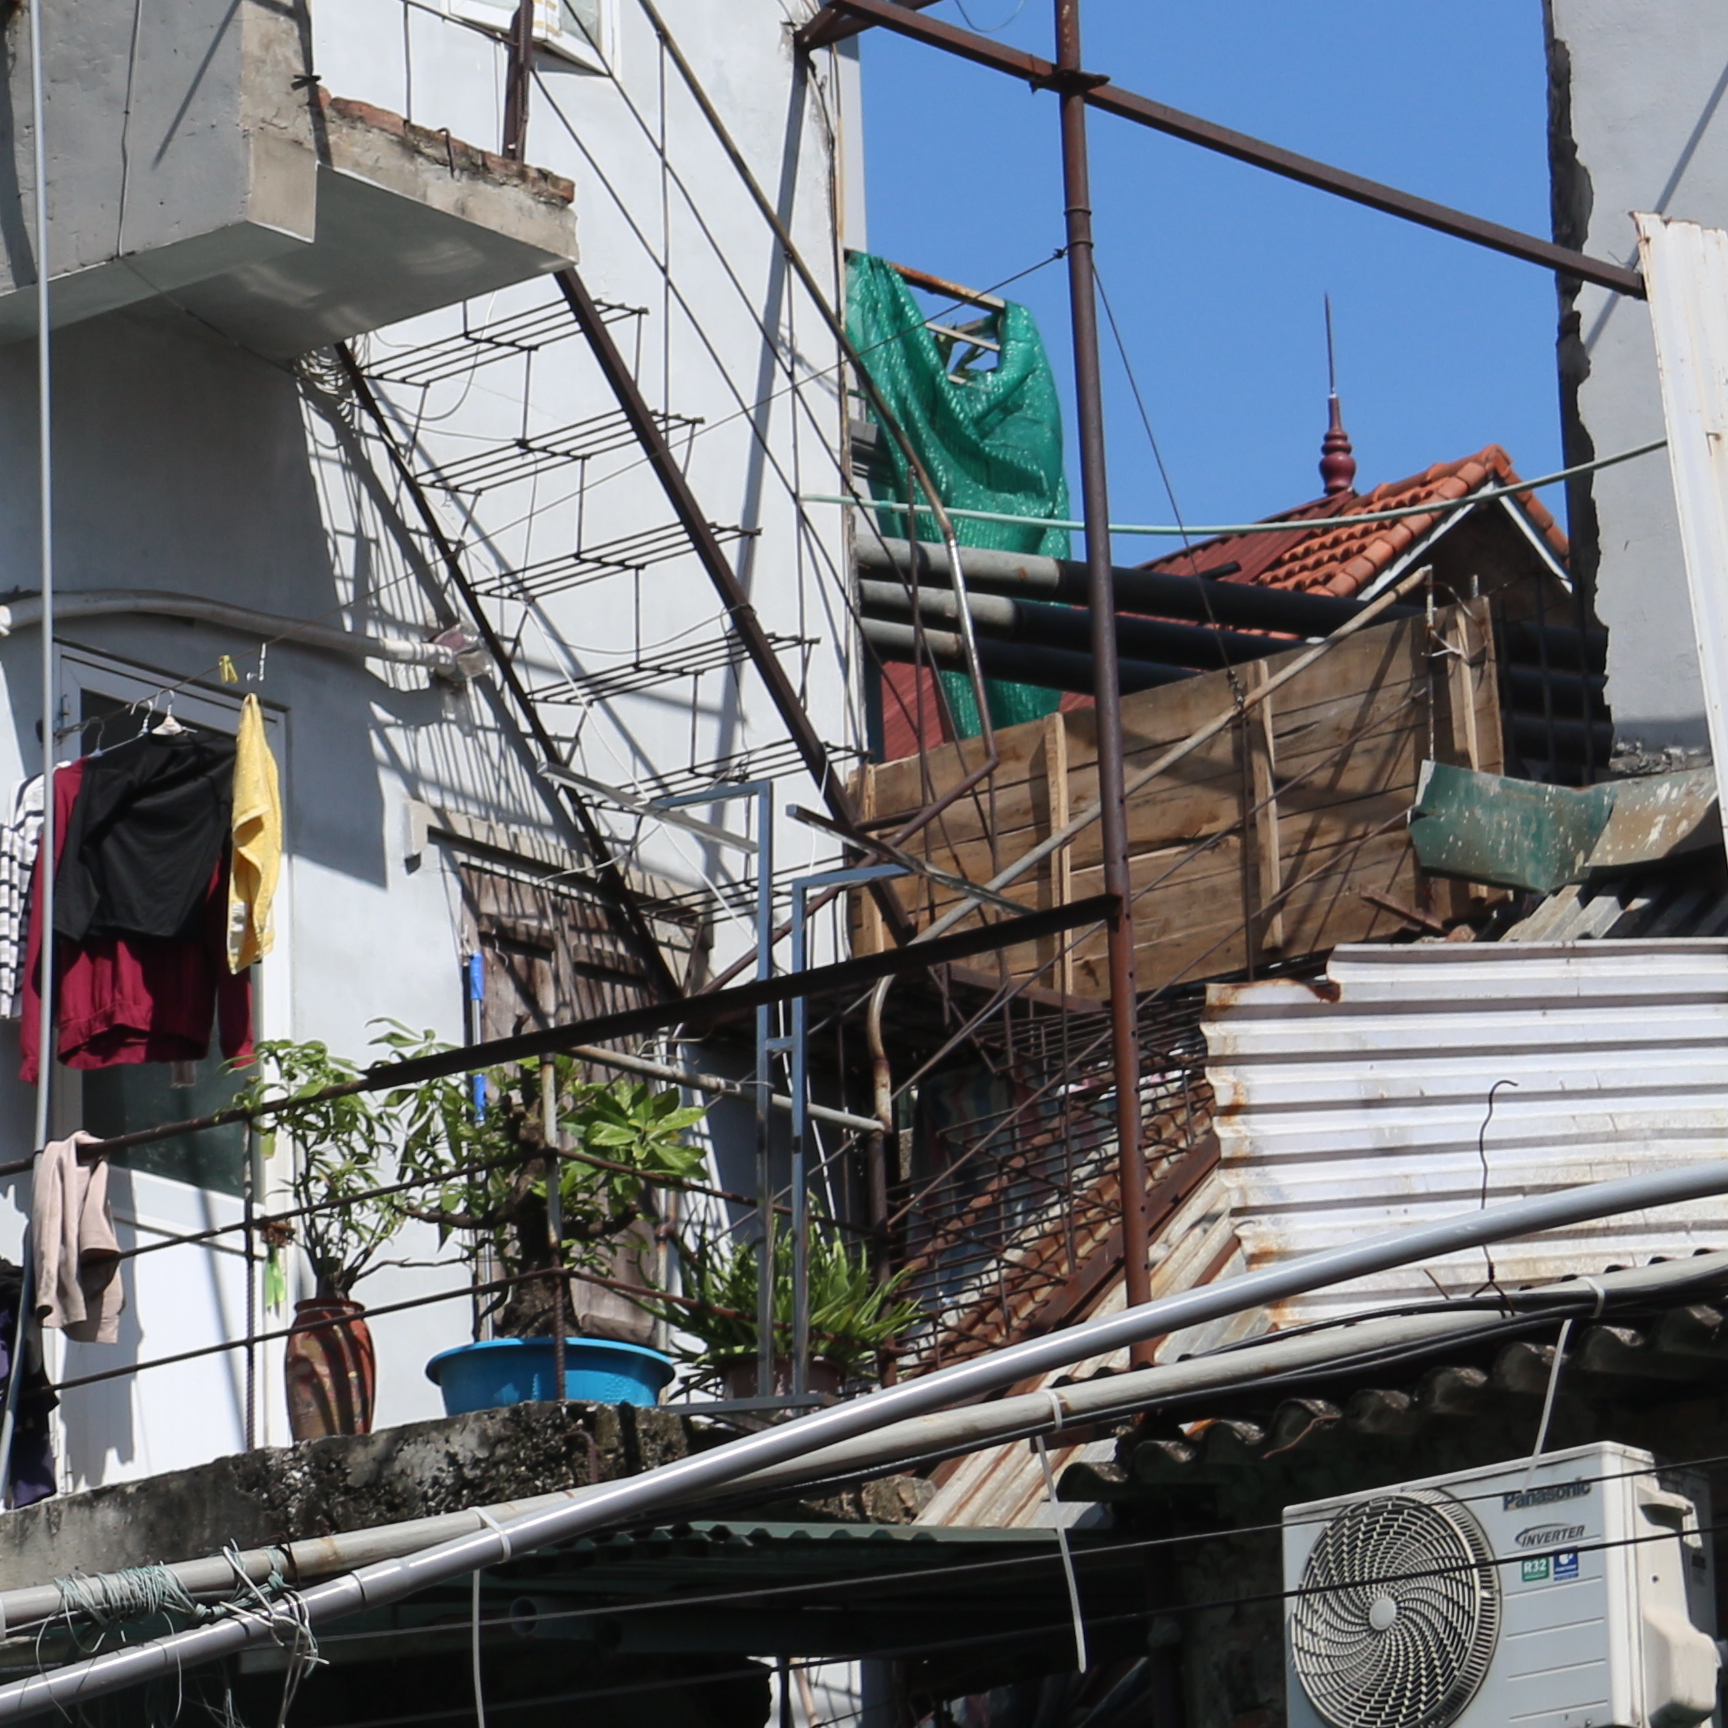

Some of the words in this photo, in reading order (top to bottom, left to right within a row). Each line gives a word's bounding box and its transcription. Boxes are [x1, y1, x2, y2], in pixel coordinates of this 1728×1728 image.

[1503, 1476, 1591, 1511] Panasonic
[1522, 1525, 1586, 1546] INVERTER
[1524, 1560, 1547, 1573] R32
